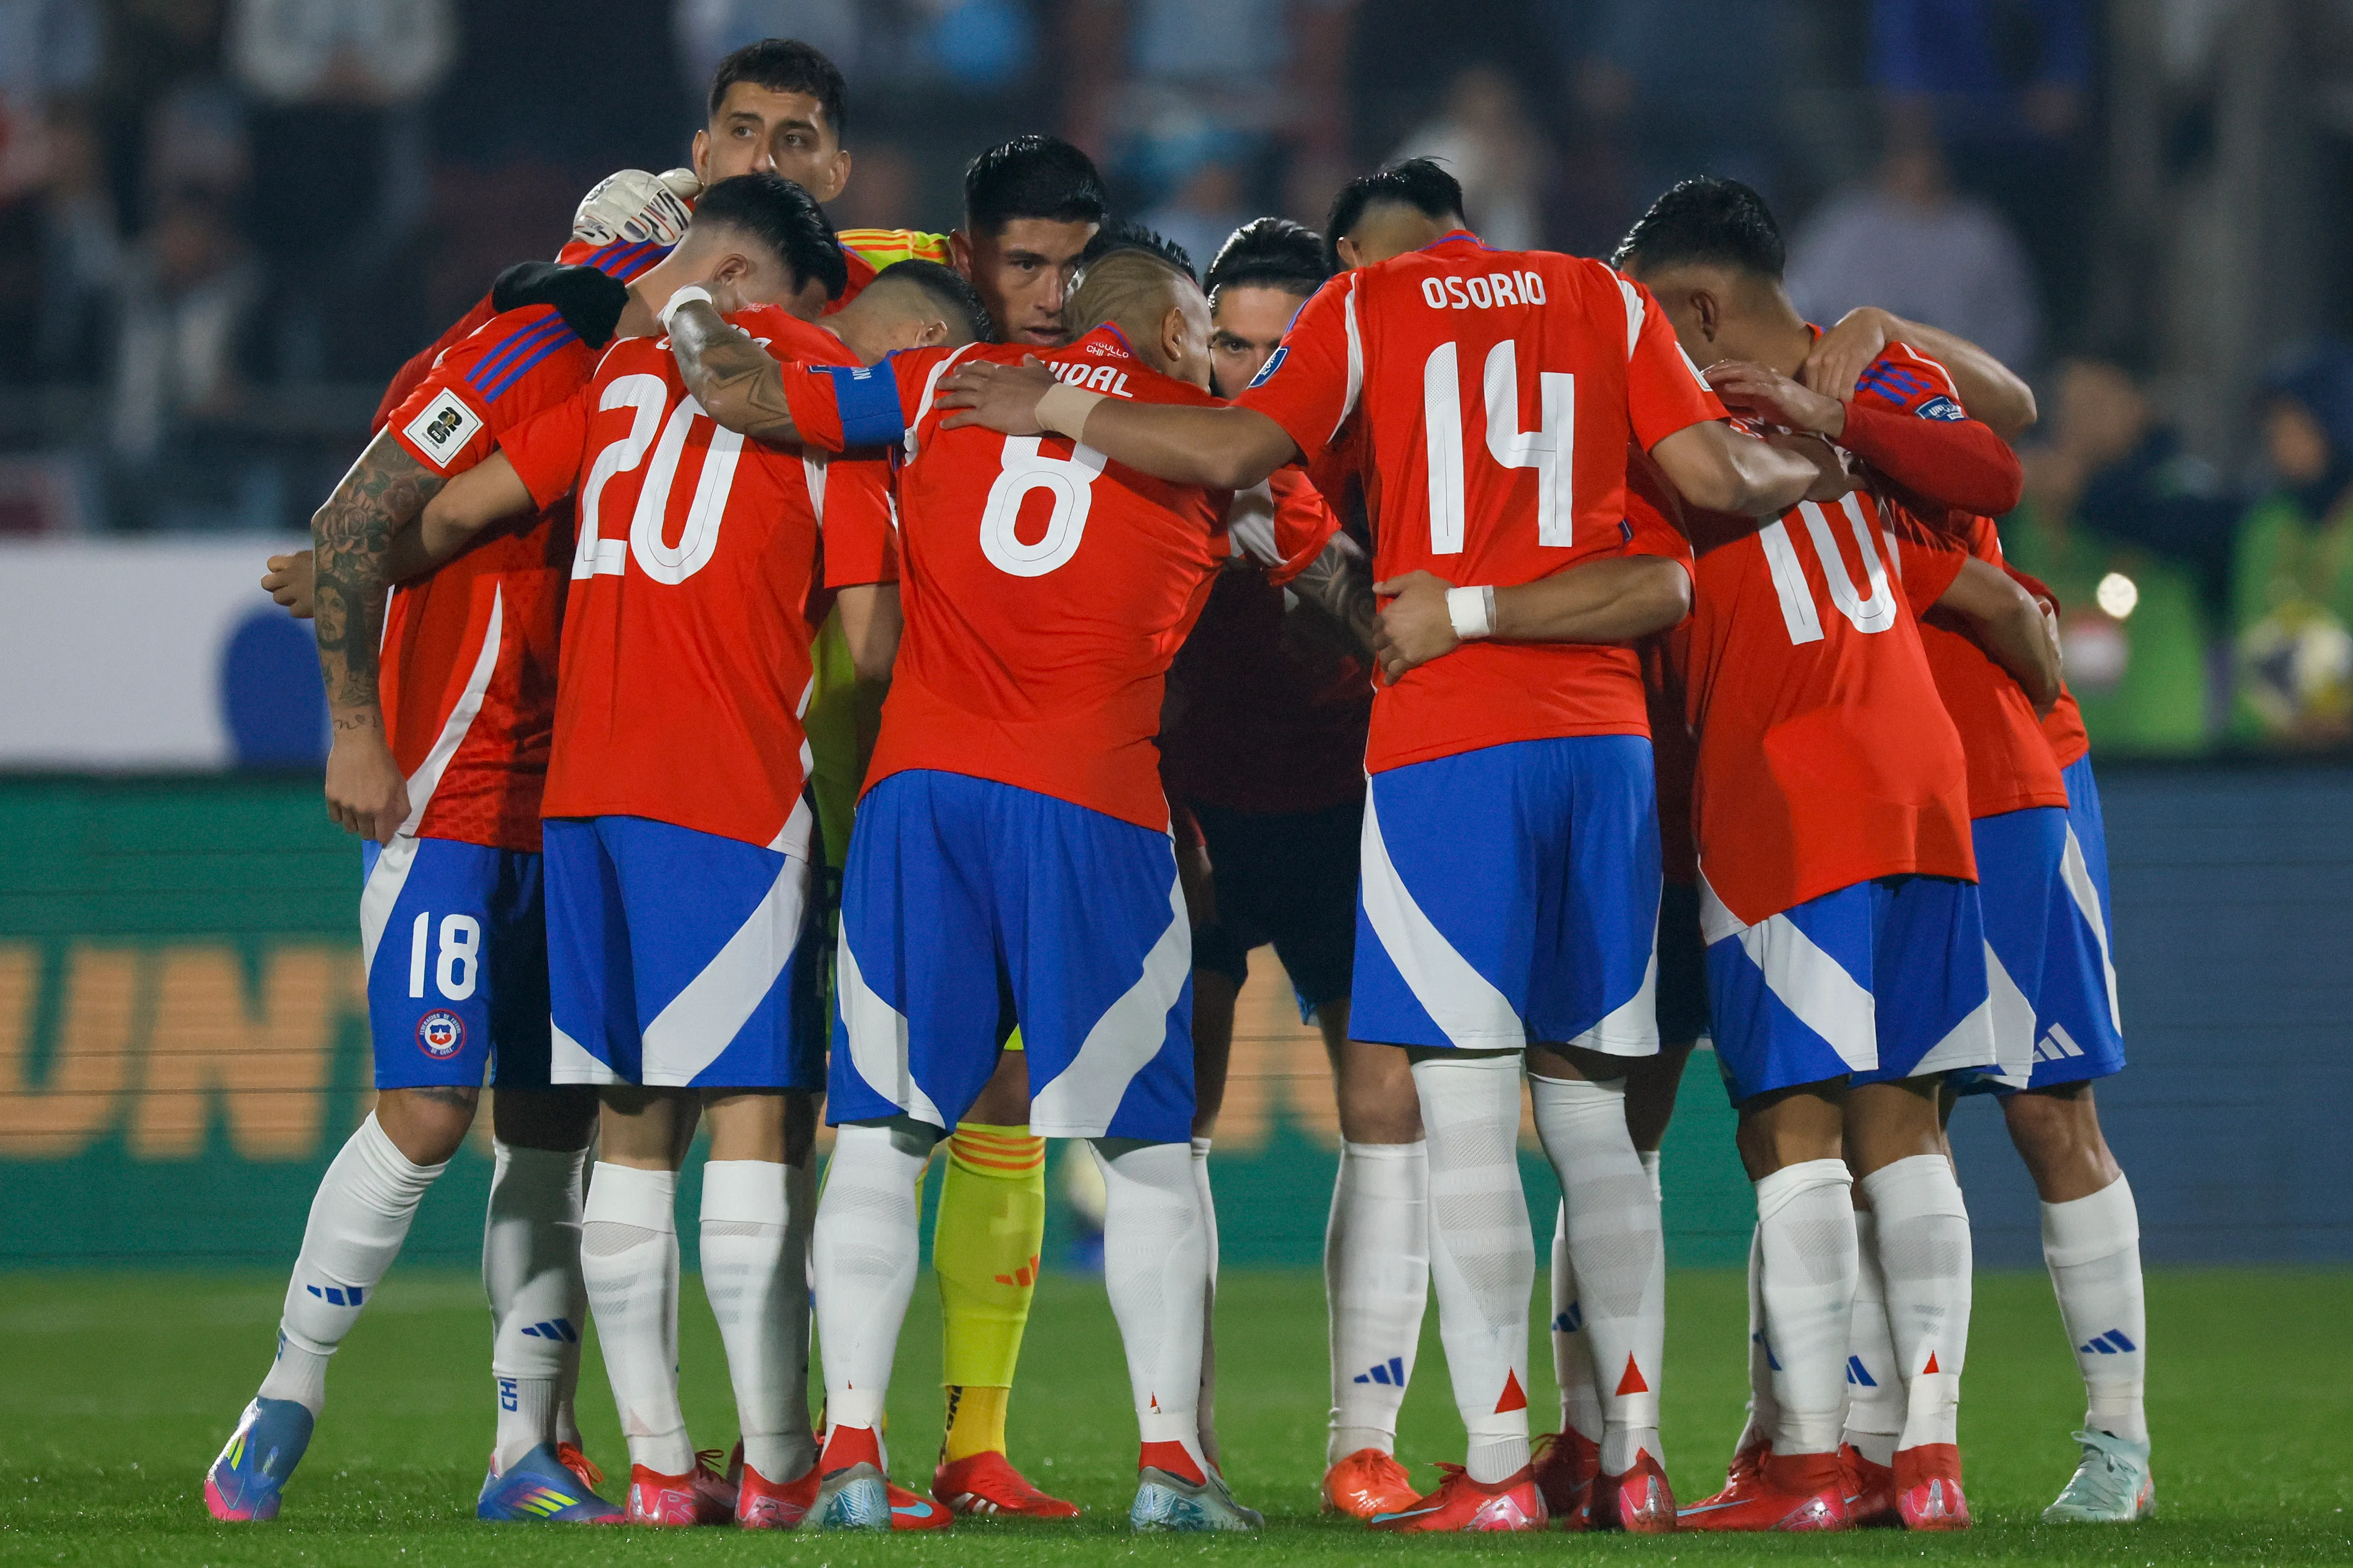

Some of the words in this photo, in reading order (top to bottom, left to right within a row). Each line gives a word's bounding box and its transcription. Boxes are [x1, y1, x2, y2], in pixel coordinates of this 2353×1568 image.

[1422, 270, 1547, 309] OSORIO
[572, 373, 744, 585] 20
[980, 435, 1108, 577] 8
[1424, 339, 1574, 555] 14
[1759, 490, 1896, 645] 10
[409, 912, 480, 1001] 18
